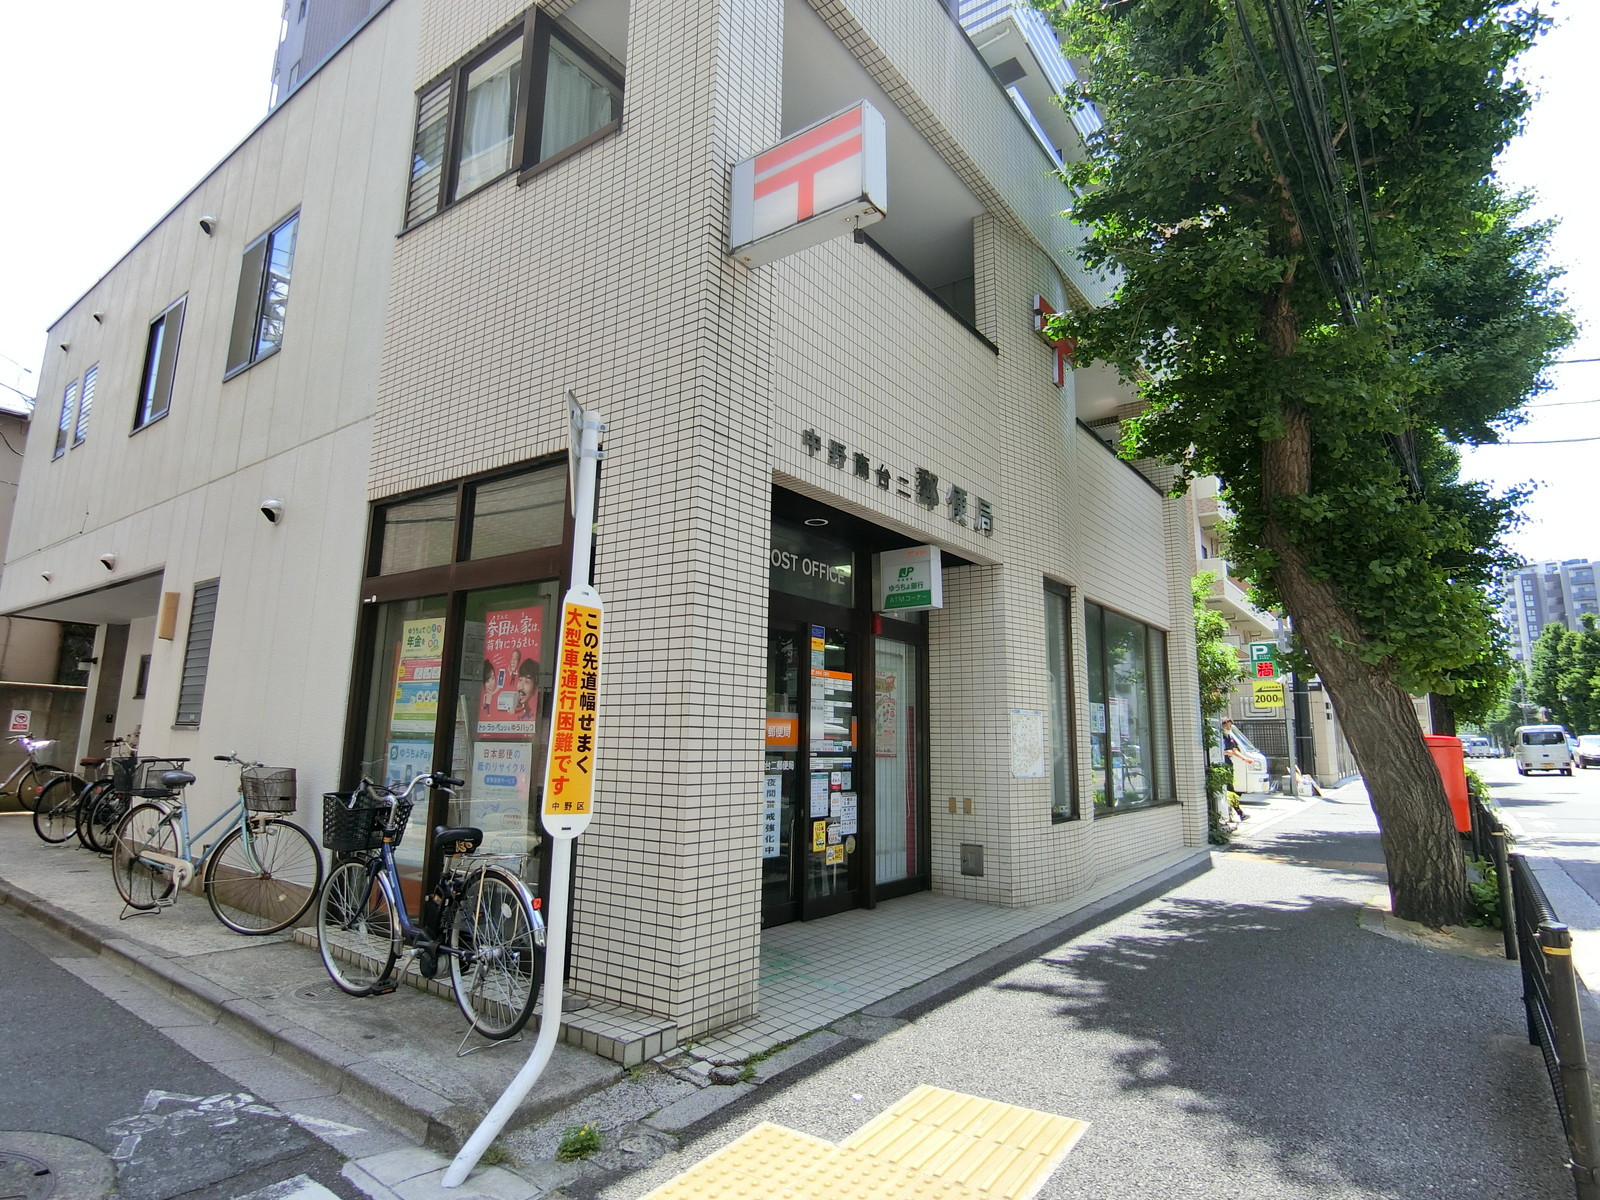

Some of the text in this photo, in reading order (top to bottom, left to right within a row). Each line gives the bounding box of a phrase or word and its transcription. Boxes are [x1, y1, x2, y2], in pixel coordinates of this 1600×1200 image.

[771, 549, 846, 585] OST OFFICE
[889, 581, 924, 591] ゆうちょ銀行
[889, 594, 928, 604] ATMコーナー
[1252, 645, 1268, 660] P
[576, 613, 599, 774] この先道幅せまく
[552, 608, 583, 796] 大型車通行困難です
[767, 725, 791, 738] 郵便局
[400, 747, 432, 761] ゆうちょPay
[483, 749, 520, 760] 日本郵便の
[477, 761, 527, 773] 紙のリサイクル
[552, 802, 584, 811] 中野区
[764, 778, 777, 855] 夜間警戒強化中
